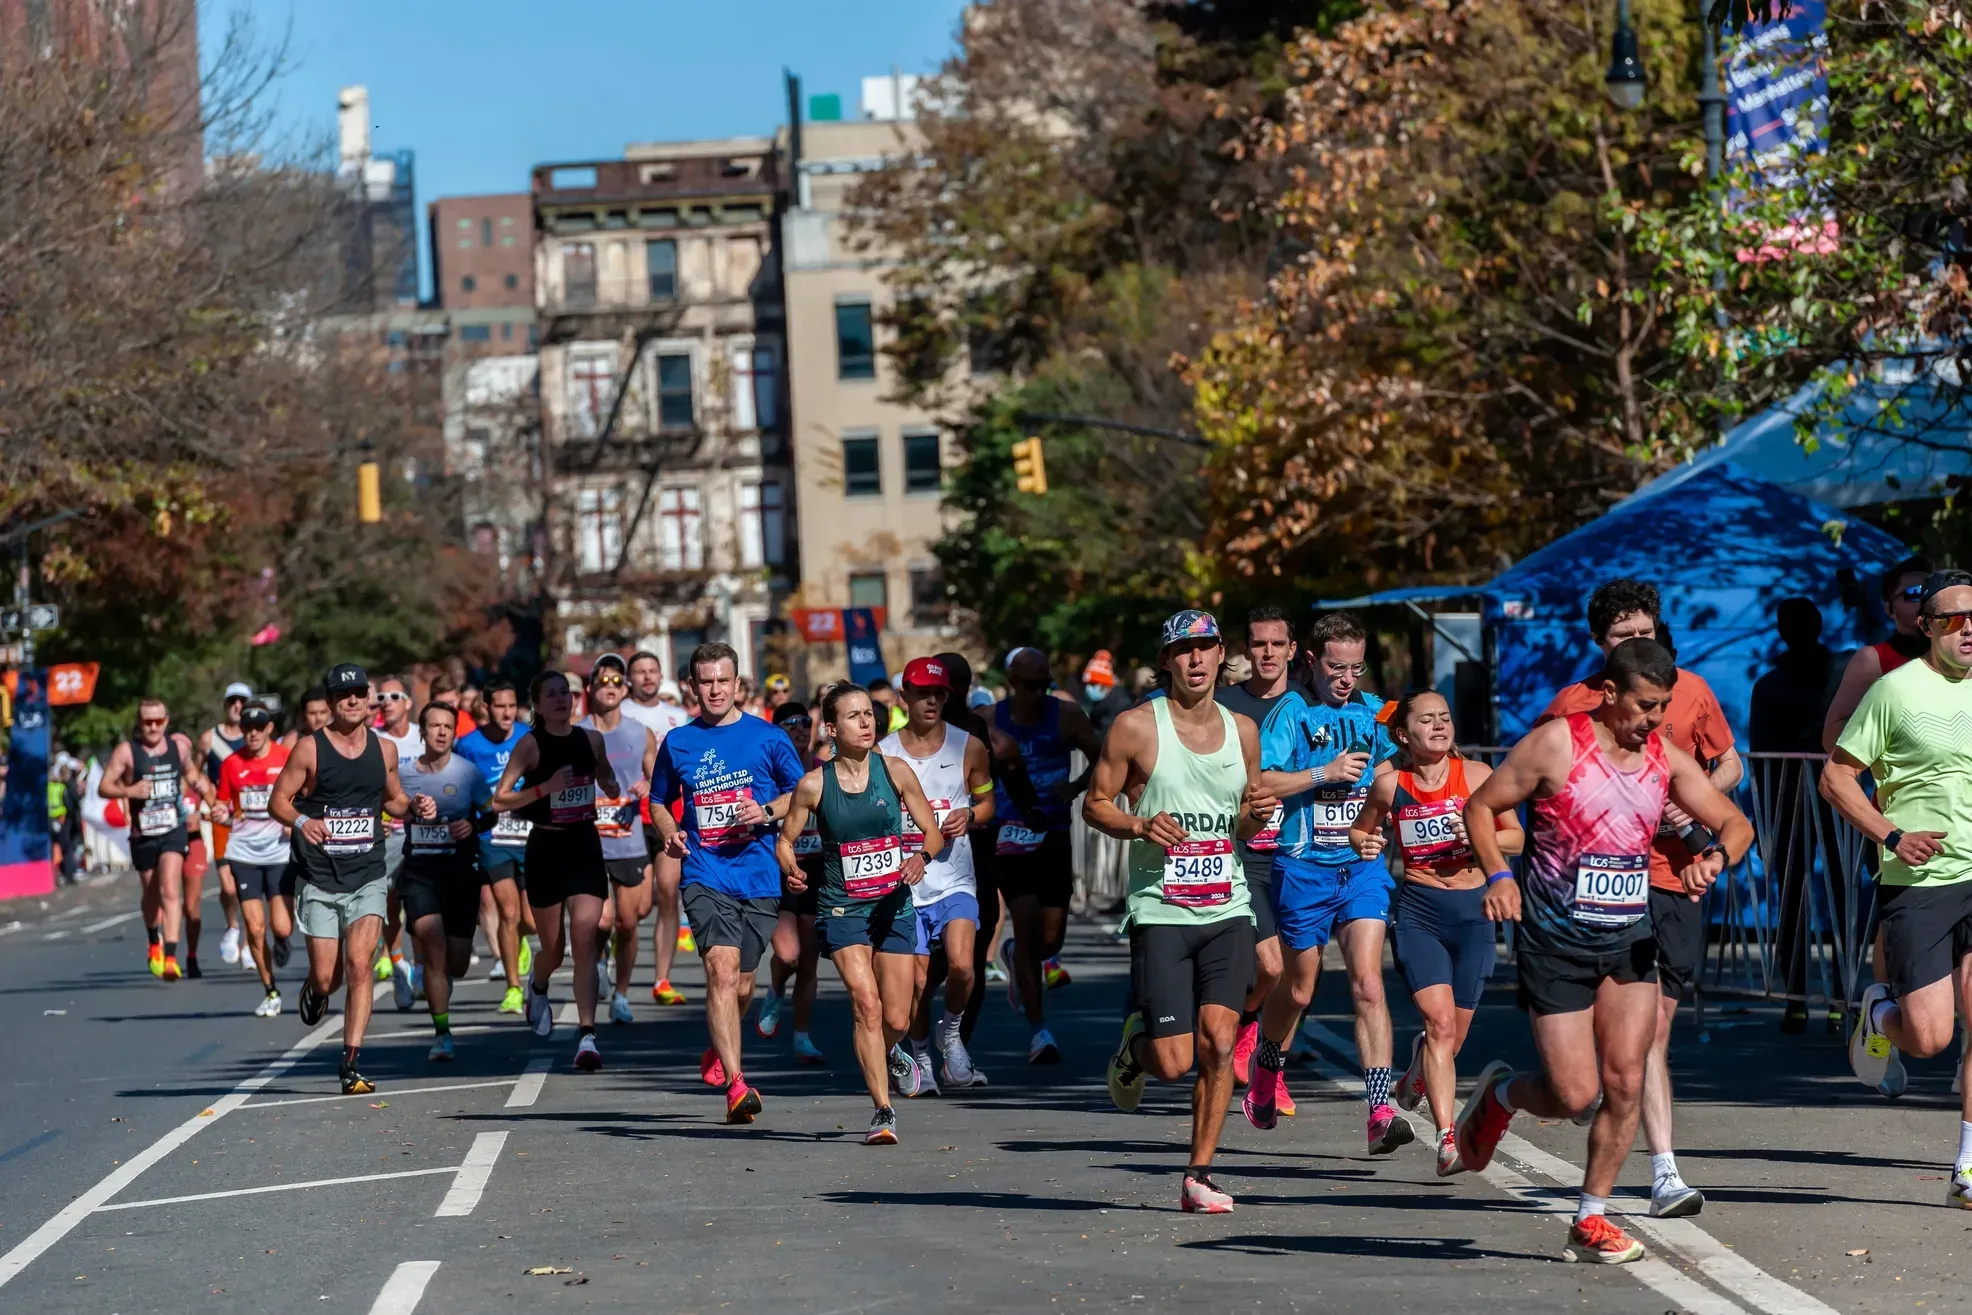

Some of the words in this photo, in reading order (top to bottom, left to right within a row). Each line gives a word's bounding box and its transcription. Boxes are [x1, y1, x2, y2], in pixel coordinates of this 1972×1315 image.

[341, 671, 356, 682] NY
[699, 778, 716, 788] RUN
[716, 774, 732, 784] FOR
[559, 787, 588, 802] 4991
[702, 796, 714, 804] tcs
[1321, 789, 1336, 799] tcs
[1405, 808, 1418, 817] tcs
[329, 819, 370, 834] 12222
[500, 820, 528, 832] 5834
[848, 845, 862, 854] tcs
[1174, 846, 1189, 854] tcs
[852, 851, 892, 874] 7339
[1174, 856, 1223, 878] 5489
[1590, 855, 1608, 868] tcs
[1584, 872, 1644, 896] 10007
